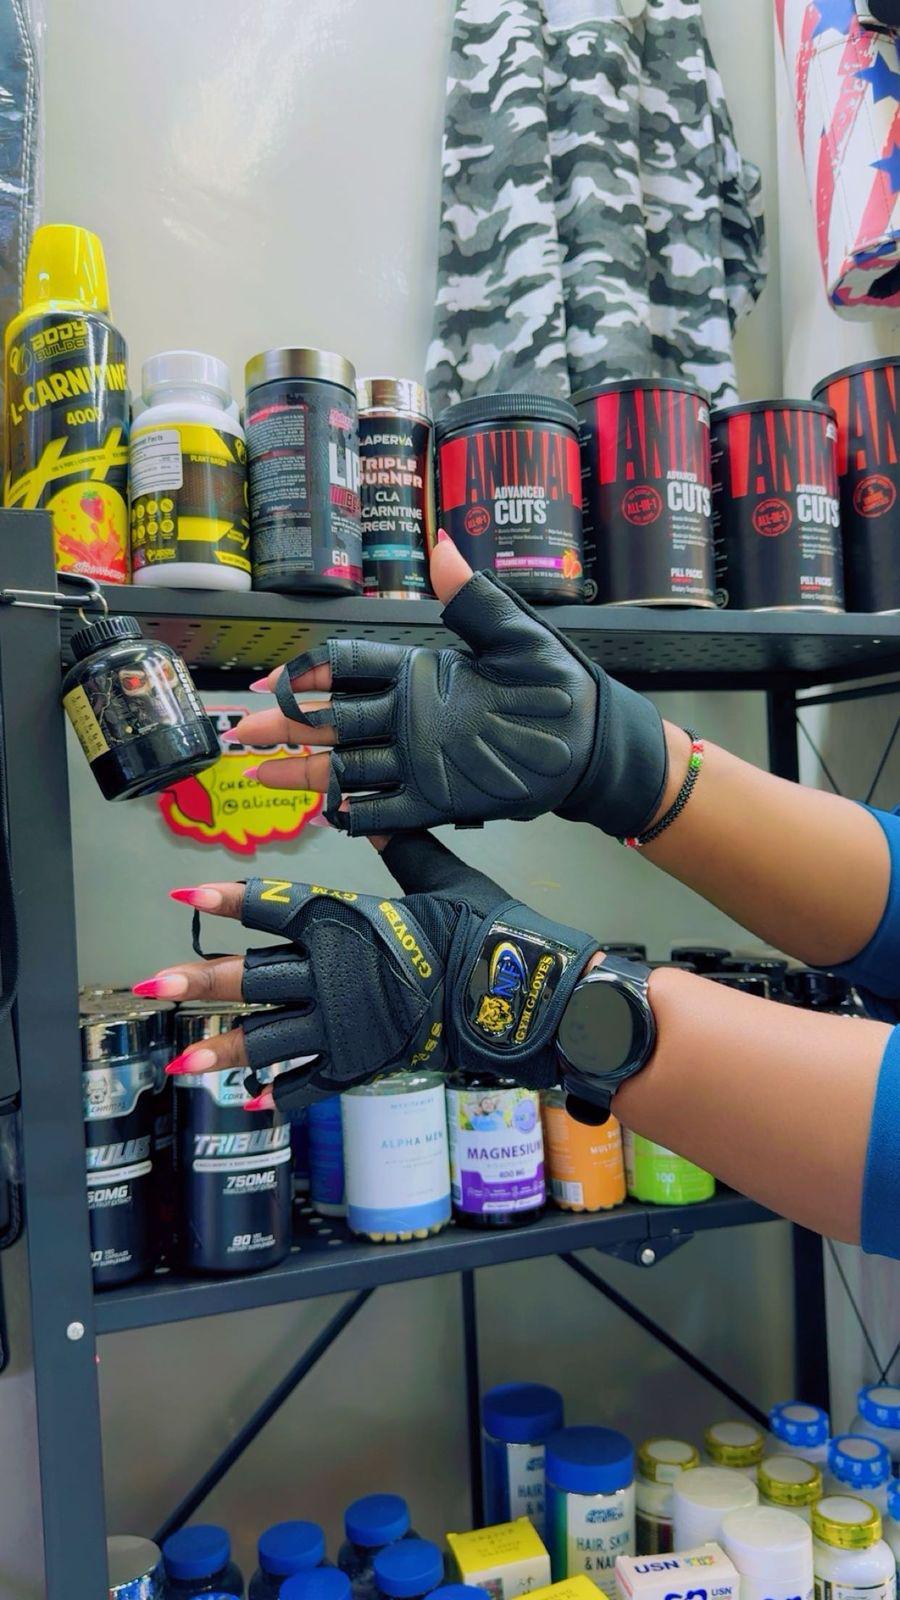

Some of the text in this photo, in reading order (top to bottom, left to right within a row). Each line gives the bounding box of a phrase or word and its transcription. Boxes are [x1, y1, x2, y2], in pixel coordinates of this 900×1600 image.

[31, 318, 87, 351] BODY
[359, 456, 417, 473] TRIPLE
[374, 491, 400, 503] CLA
[494, 485, 545, 499] ADVANCED
[667, 481, 712, 518] CUTS
[494, 499, 550, 526] CUTS
[797, 494, 840, 528] CUTS
[398, 521, 421, 535] TEA
[331, 549, 350, 567] 60
[670, 567, 684, 578] PILL
[378, 901, 433, 979] GLOVES
[514, 953, 554, 1042] GYM GLOVES
[381, 1137, 422, 1150] ALPHA
[226, 1170, 277, 1189] 750MG
[609, 1530, 631, 1550] SKIN
[583, 1556, 593, 1571] &
[634, 1559, 680, 1575] USN
[710, 1586, 734, 1597] USN
